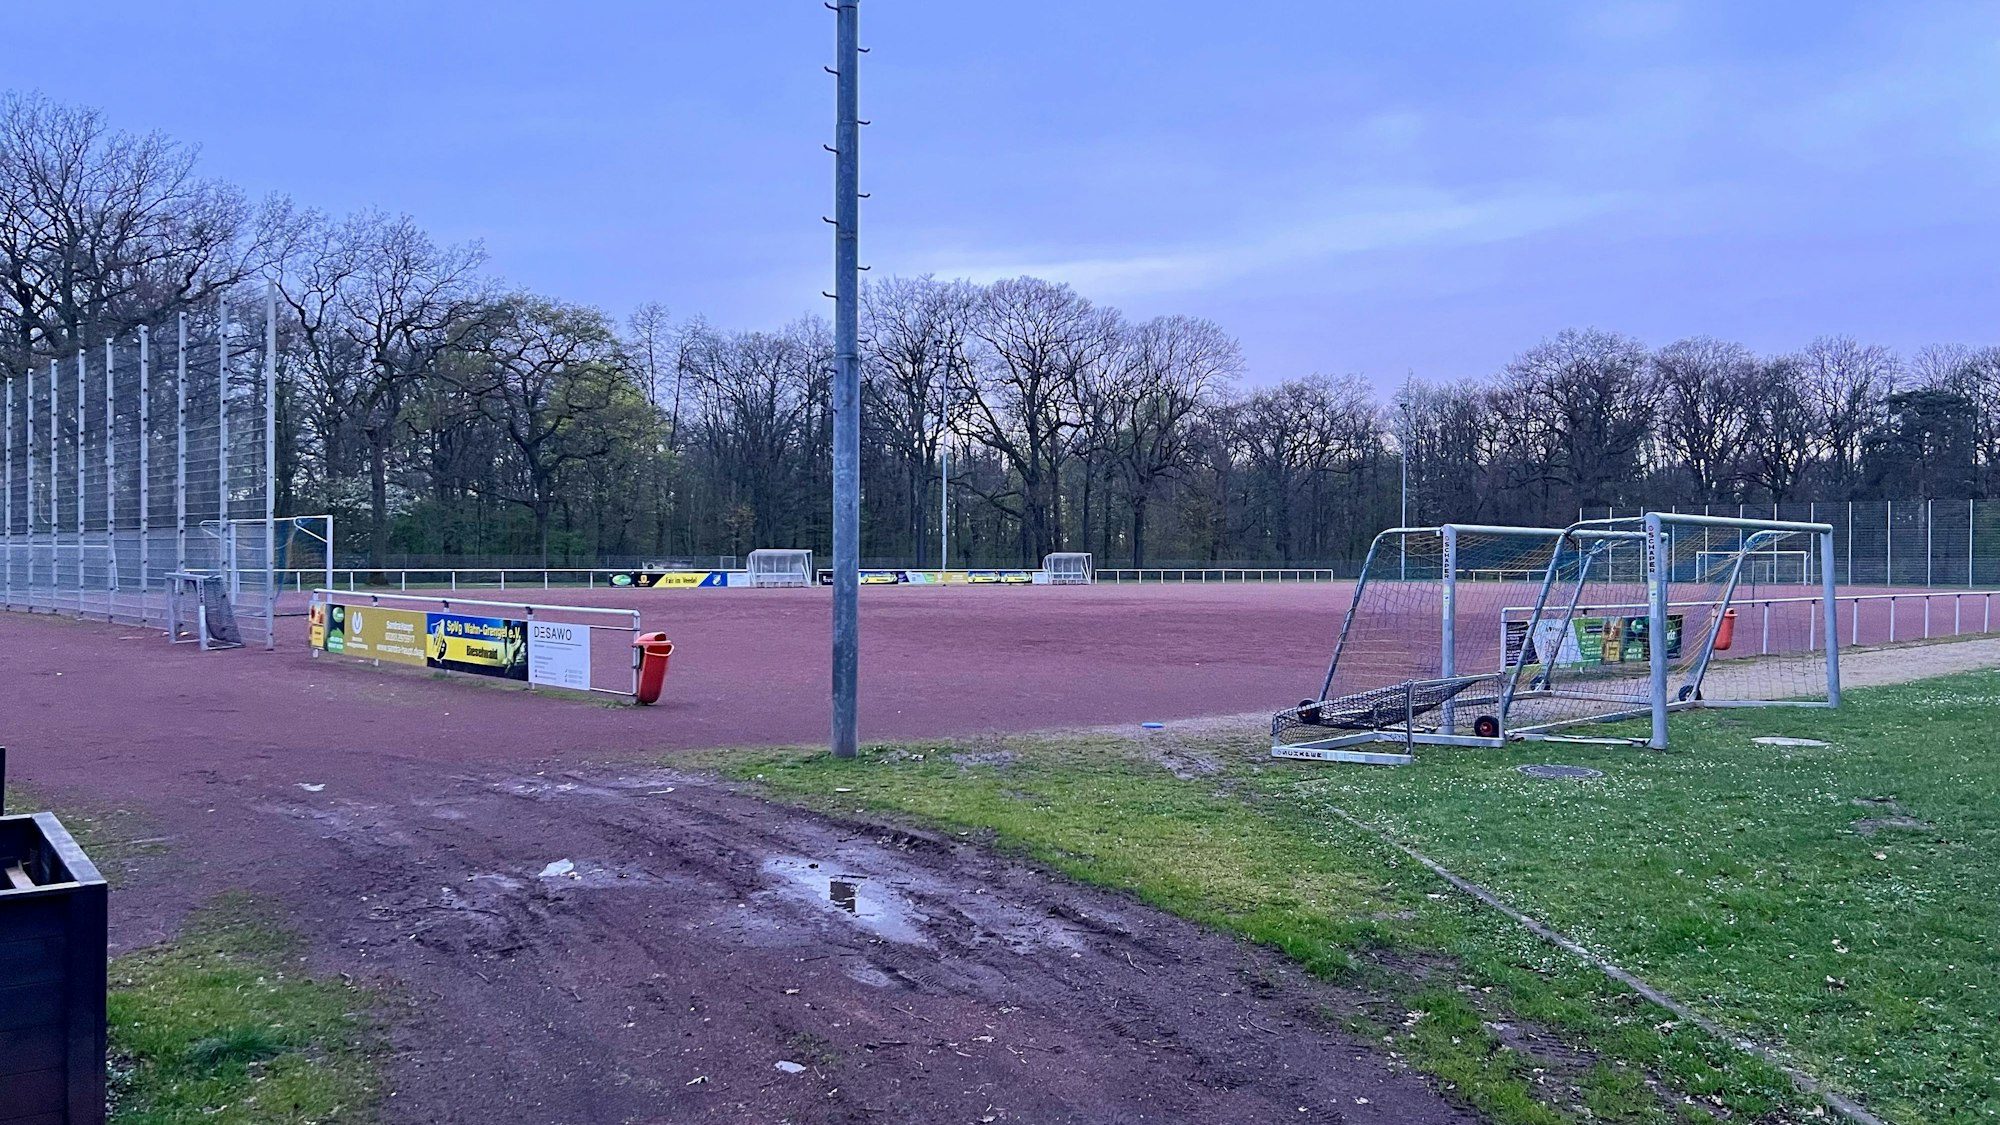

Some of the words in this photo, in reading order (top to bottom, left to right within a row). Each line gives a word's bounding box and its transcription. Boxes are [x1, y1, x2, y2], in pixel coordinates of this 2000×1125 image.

[446, 619, 463, 636] SpVg
[508, 626, 522, 639] e.V.
[534, 626, 572, 641] DESAWO
